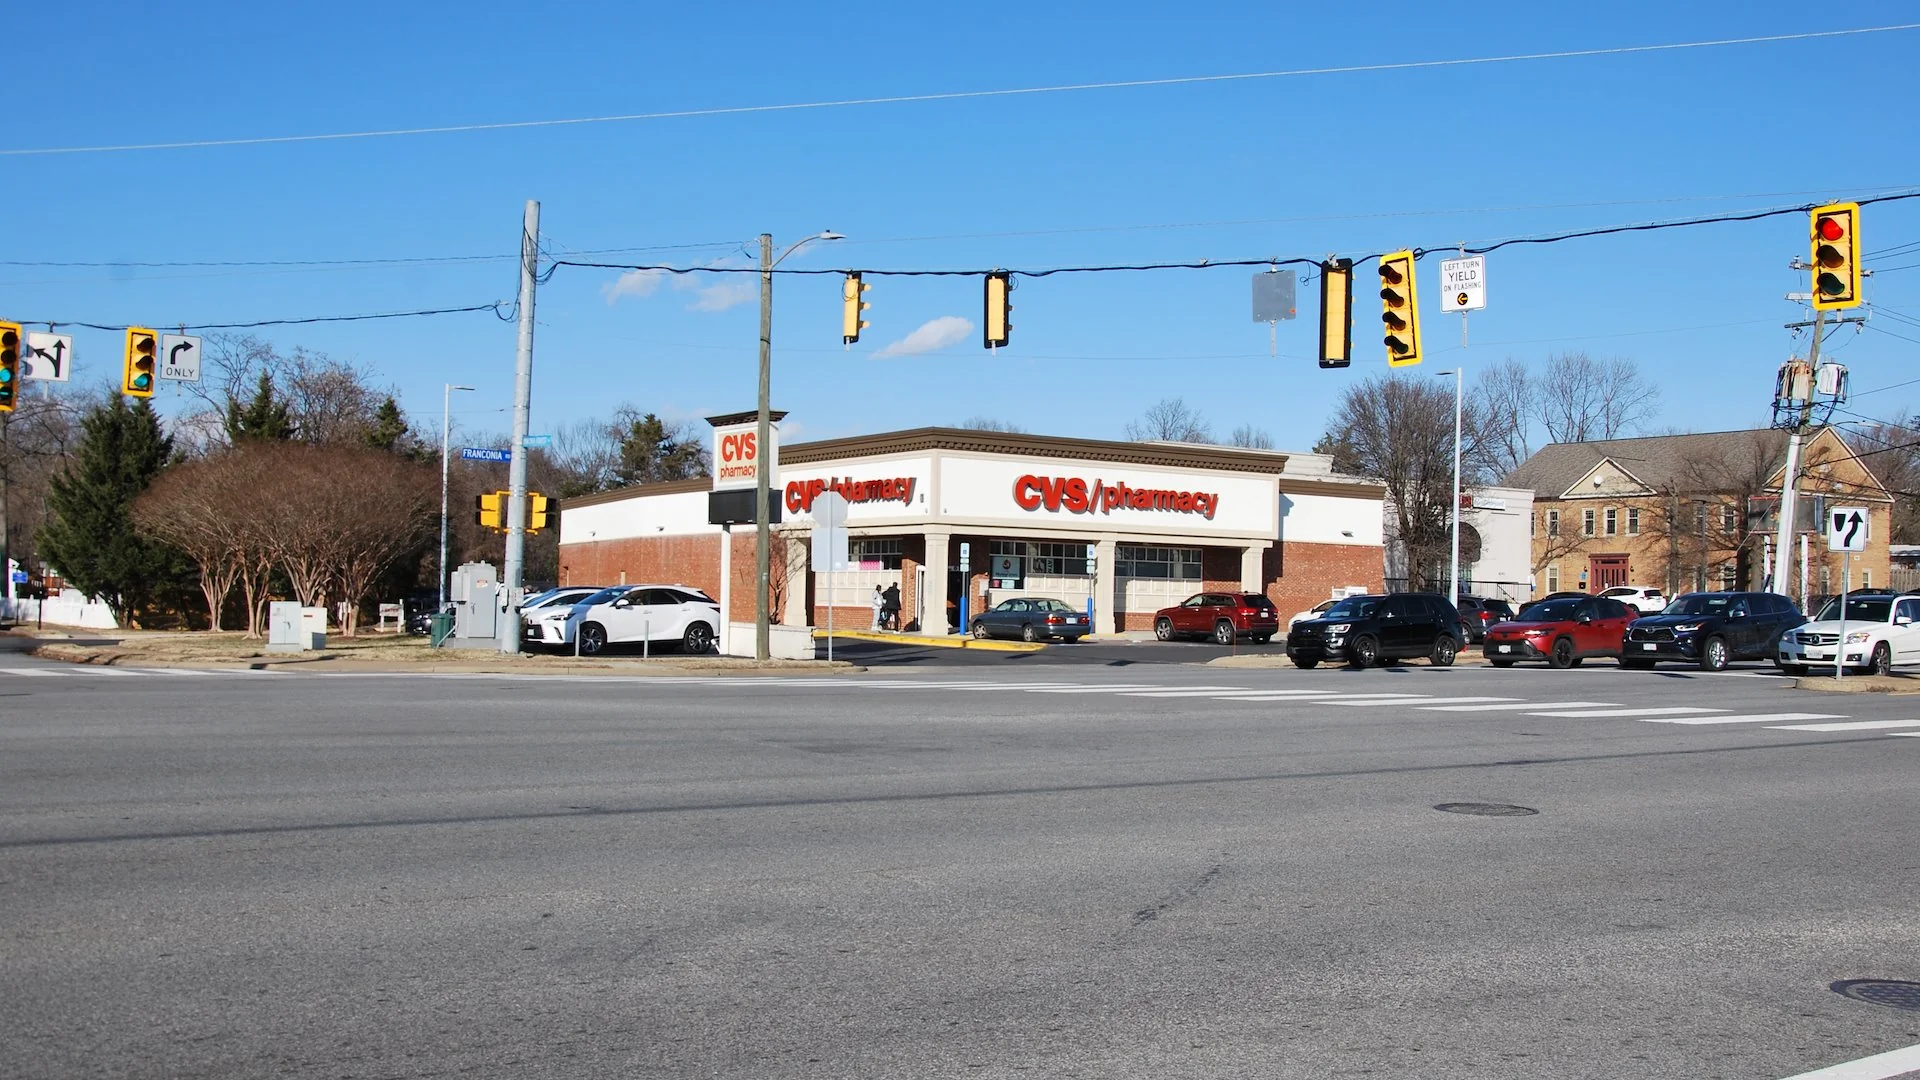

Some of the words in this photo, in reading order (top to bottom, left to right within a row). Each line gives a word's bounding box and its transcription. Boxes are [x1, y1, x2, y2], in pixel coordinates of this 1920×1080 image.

[1444, 262, 1459, 271] LEFT
[1462, 260, 1480, 269] TURN
[1448, 270, 1477, 282] YIELD
[1444, 284, 1452, 292] ON
[1454, 281, 1482, 291] FLASHING
[166, 367, 195, 377] ONLY
[721, 432, 756, 462] CVS
[463, 448, 503, 460] FRANCONIA
[720, 464, 757, 481] pharmacy
